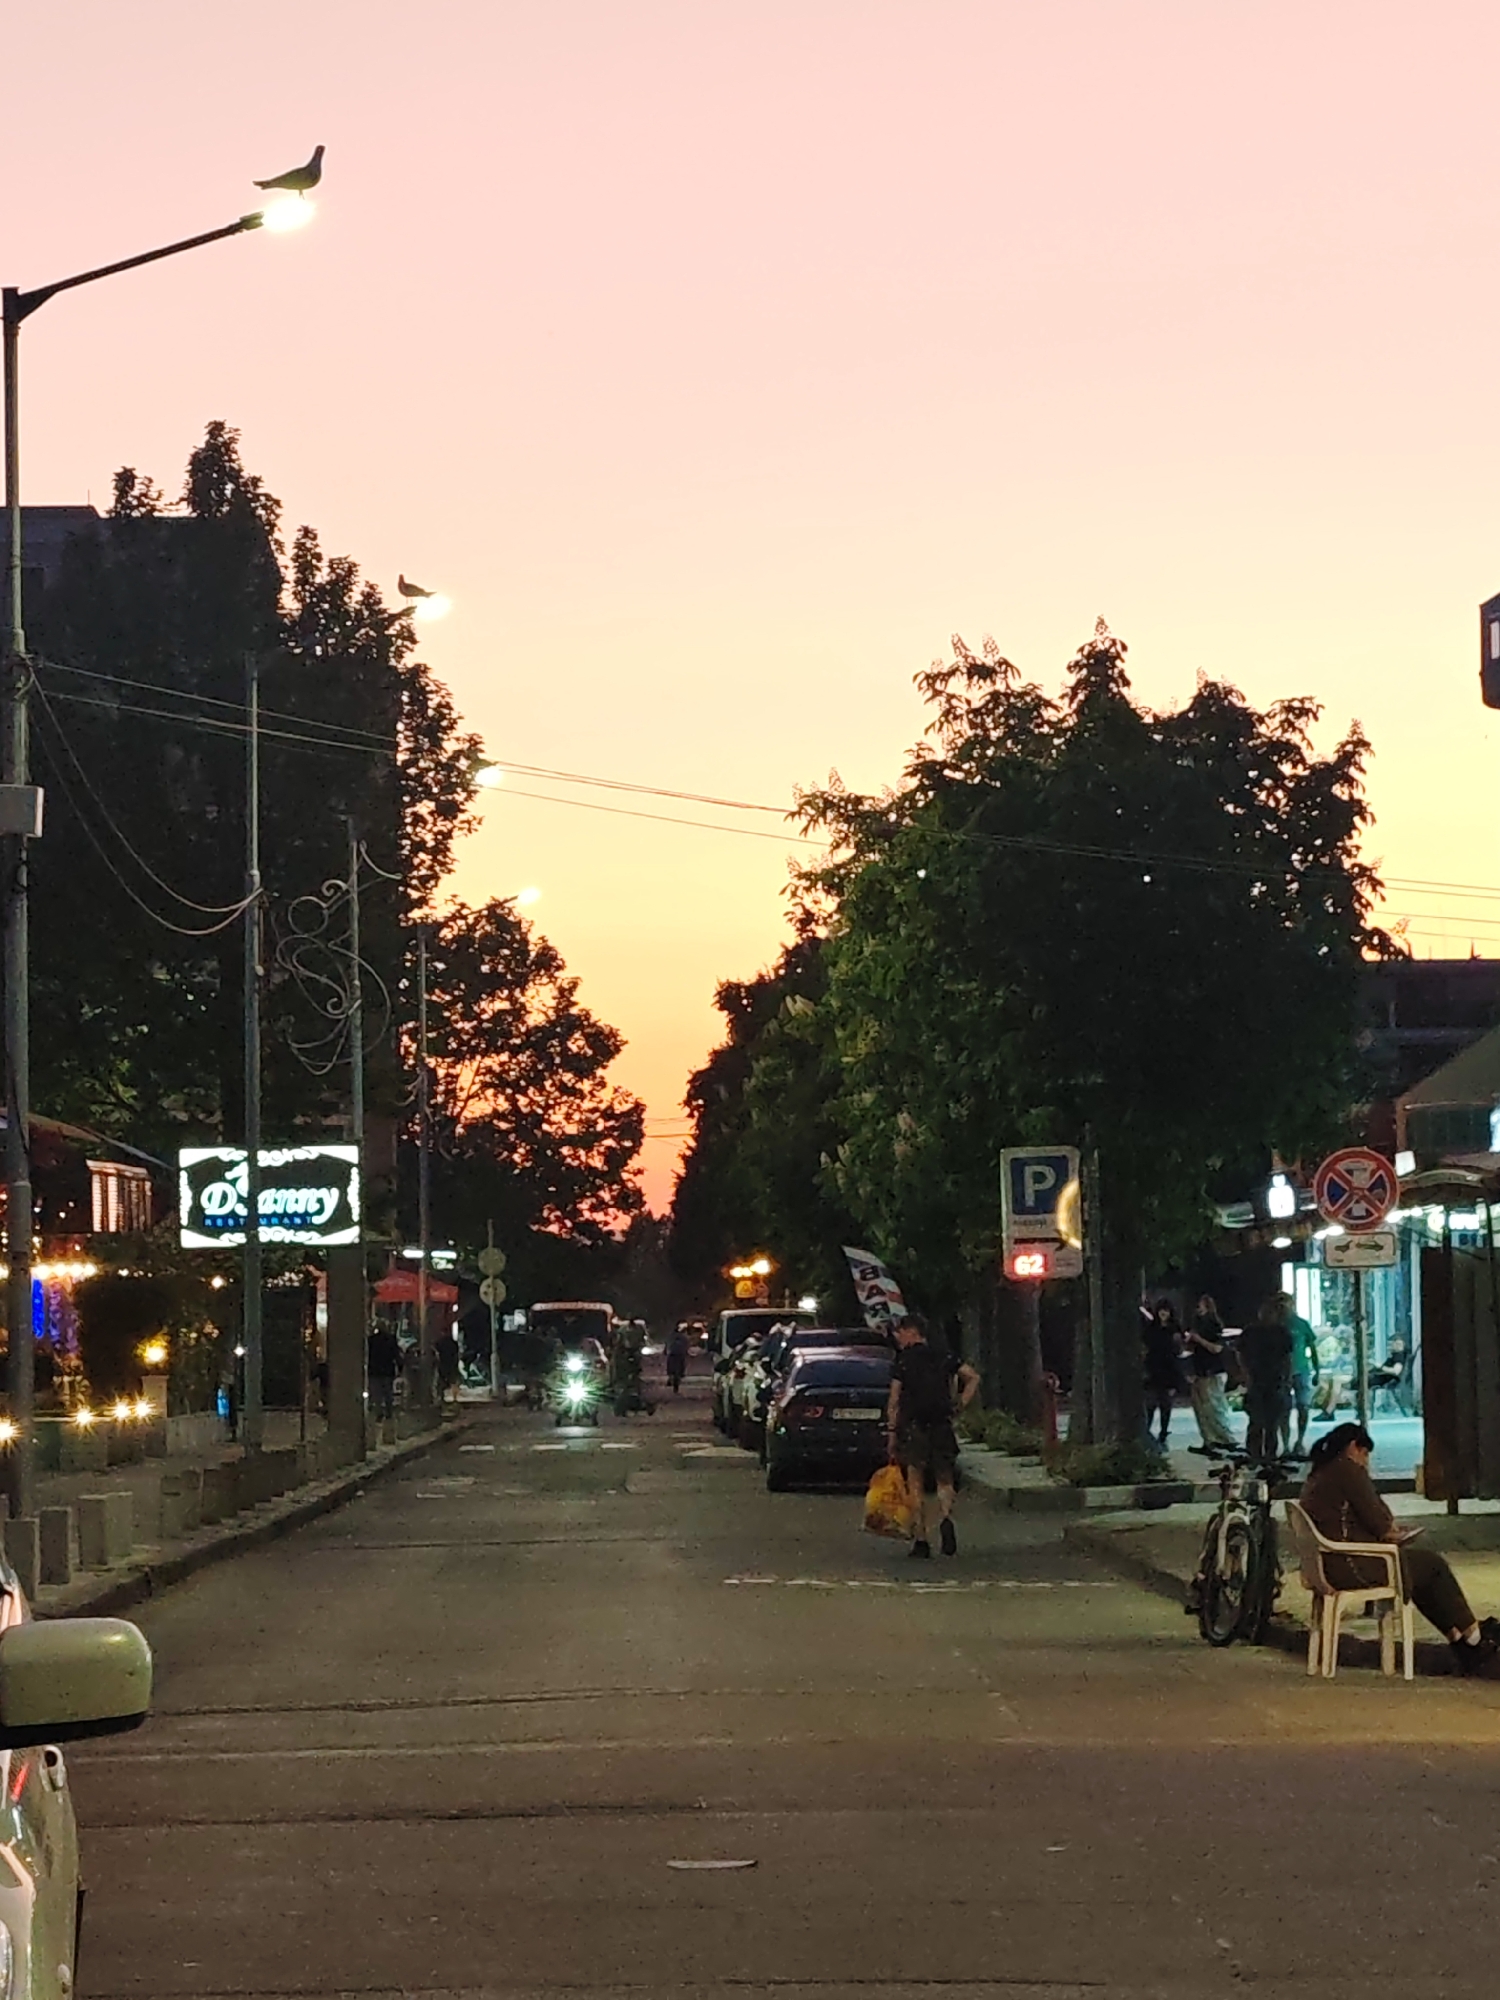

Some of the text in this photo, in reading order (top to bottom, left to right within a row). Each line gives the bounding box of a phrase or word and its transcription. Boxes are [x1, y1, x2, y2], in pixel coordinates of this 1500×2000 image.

[1024, 1165, 1057, 1207] P
[204, 1216, 312, 1227] RESTURANT
[1014, 1254, 1045, 1276] 62
